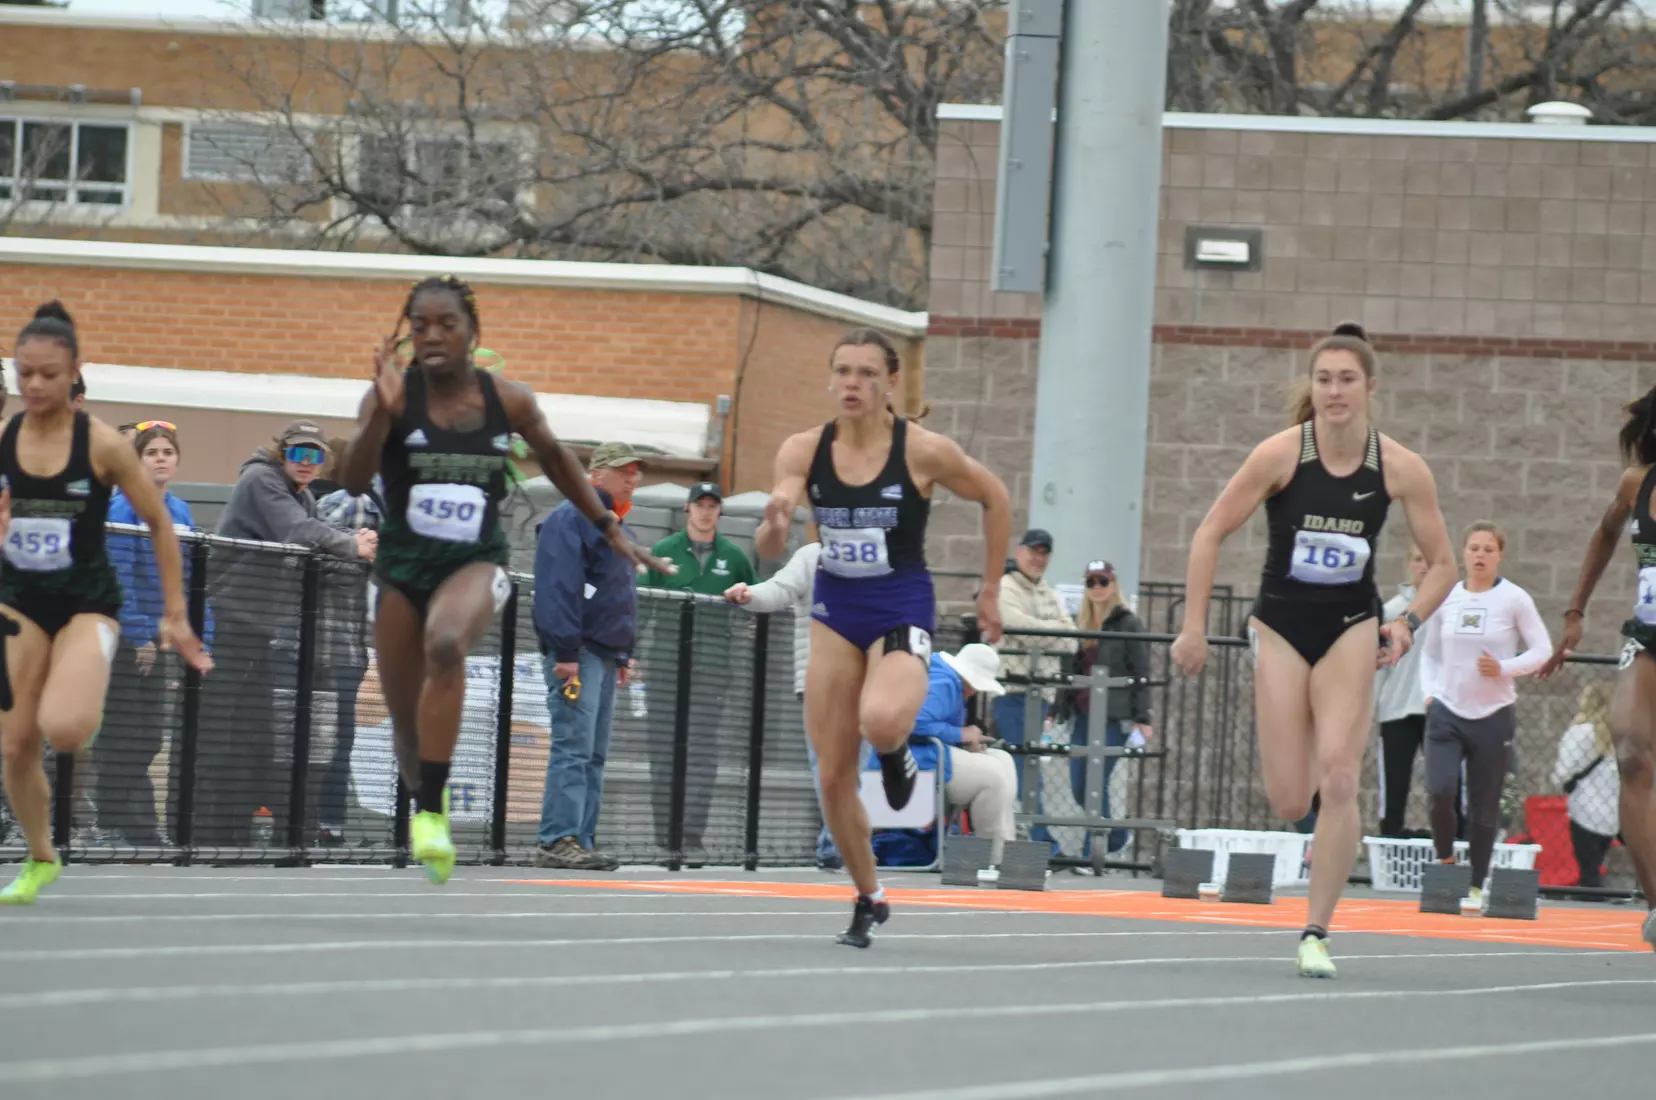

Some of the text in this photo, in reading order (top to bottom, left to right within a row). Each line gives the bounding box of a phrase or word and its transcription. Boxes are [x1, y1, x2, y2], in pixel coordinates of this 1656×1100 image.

[416, 498, 476, 521] 450
[1303, 514, 1365, 534] IDAHO
[9, 531, 60, 555] 459
[1303, 545, 1357, 569] 161
